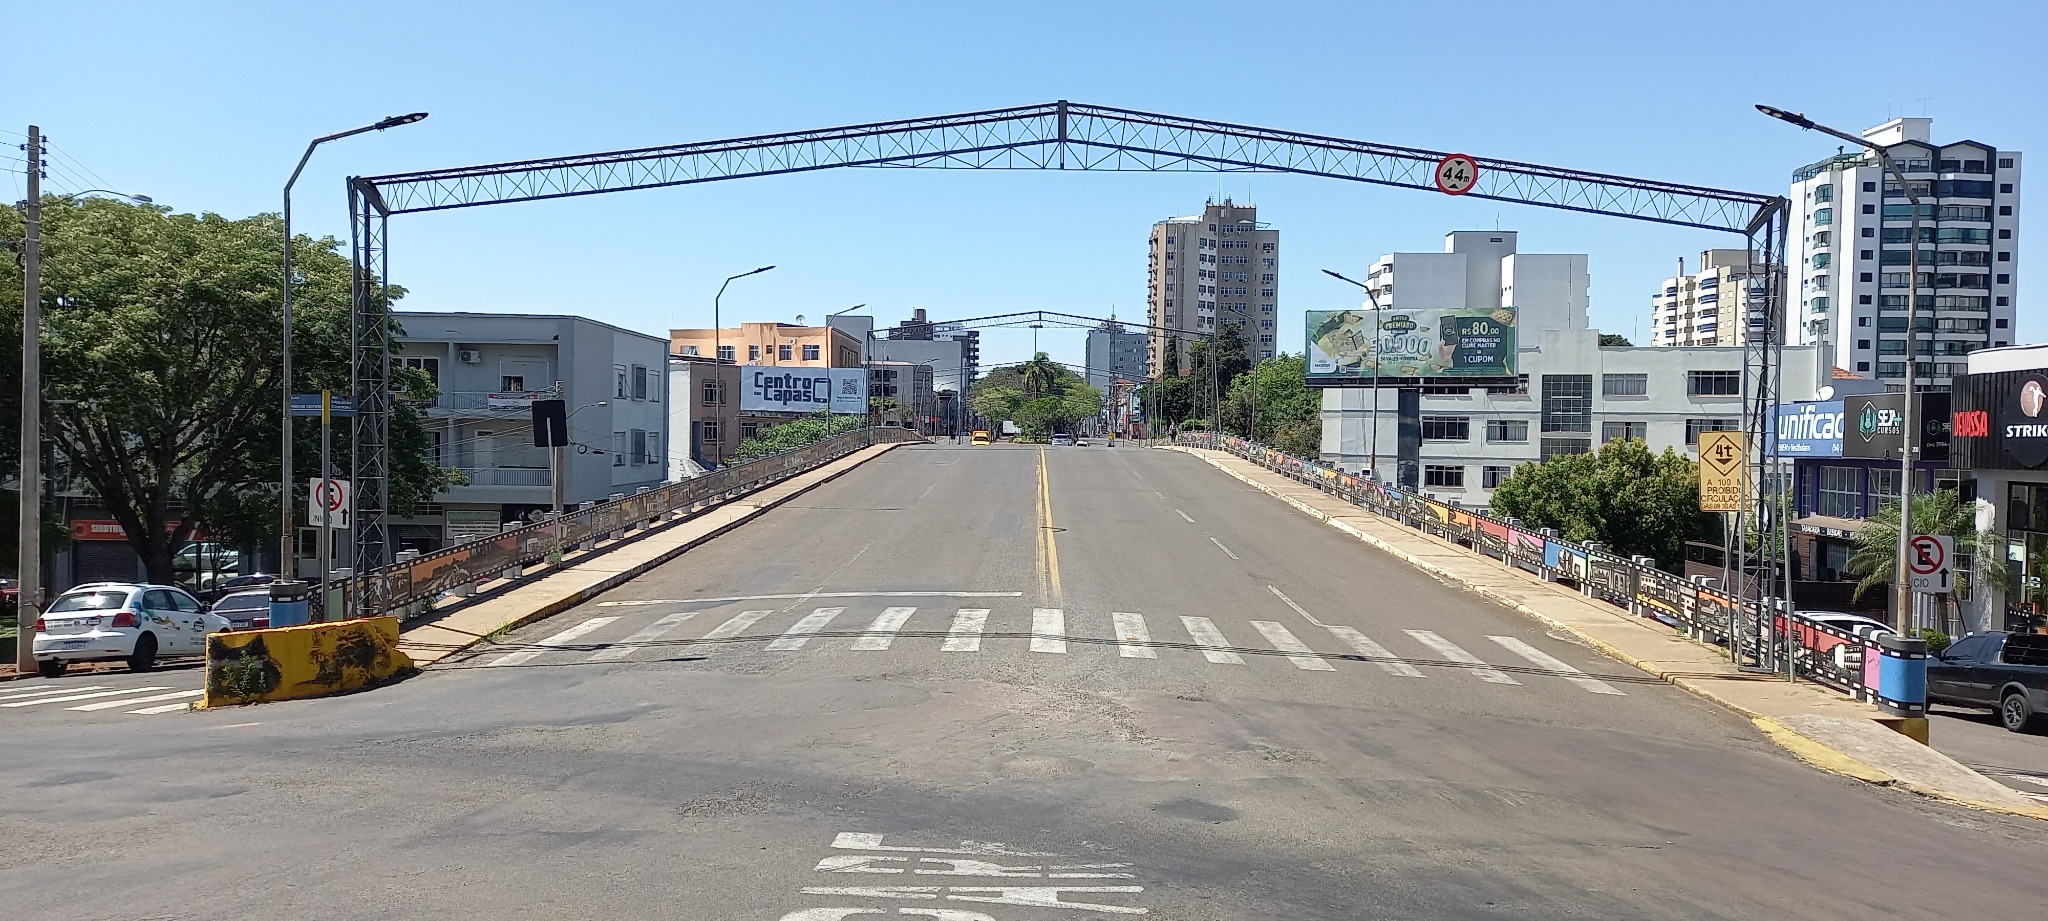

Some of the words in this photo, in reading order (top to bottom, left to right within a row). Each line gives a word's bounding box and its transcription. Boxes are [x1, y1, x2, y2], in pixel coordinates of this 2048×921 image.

[754, 371, 813, 390] Centro
[763, 385, 812, 406] Capas
[1877, 426, 1900, 435] CURSOS
[1953, 410, 1989, 437] DEVASSA
[2006, 424, 2048, 438] STRIK
[1715, 444, 1733, 457] 4t
[1706, 478, 1713, 486] A
[1718, 478, 1731, 486] 100
